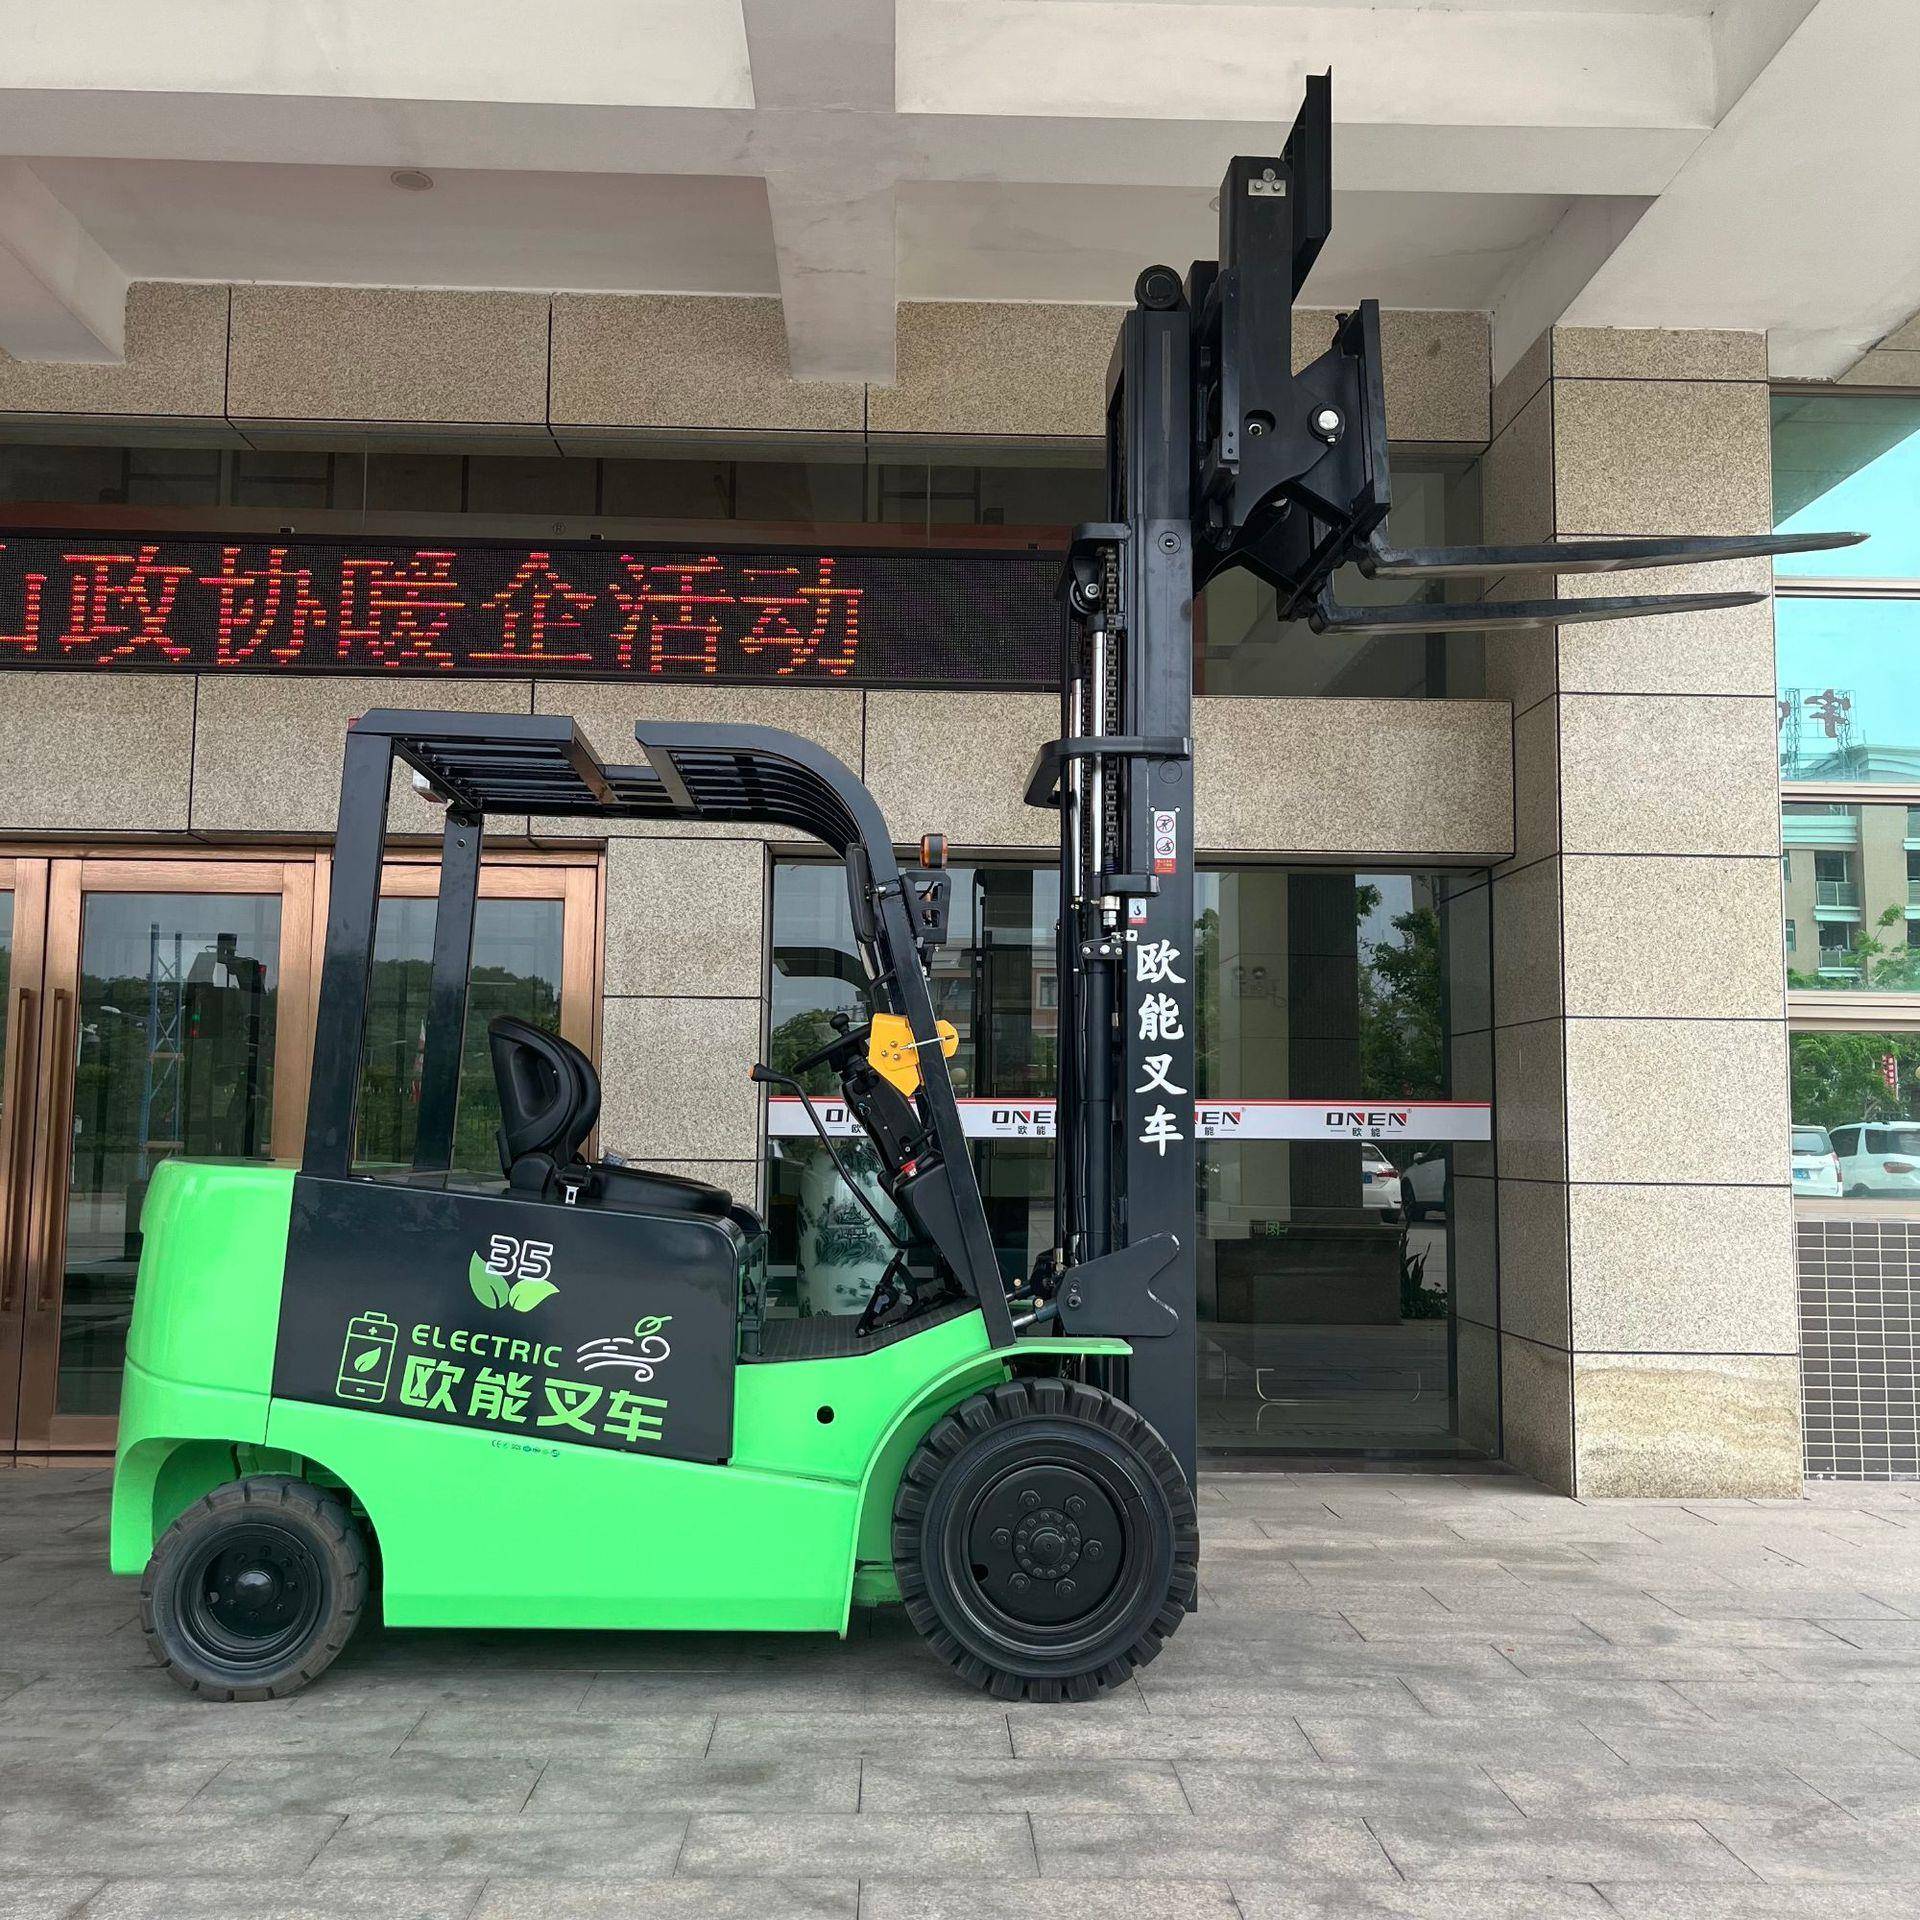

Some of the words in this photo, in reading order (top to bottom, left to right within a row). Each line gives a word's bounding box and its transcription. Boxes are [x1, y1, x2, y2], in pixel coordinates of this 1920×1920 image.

[1135, 939, 1188, 1157] 欧能叉车
[992, 1110, 1056, 1124] ONE
[1326, 1112, 1408, 1126] ONEN
[485, 1234, 554, 1281] 35
[411, 1324, 563, 1368] ELECTRIC
[399, 1354, 669, 1442] 欧能叉车
